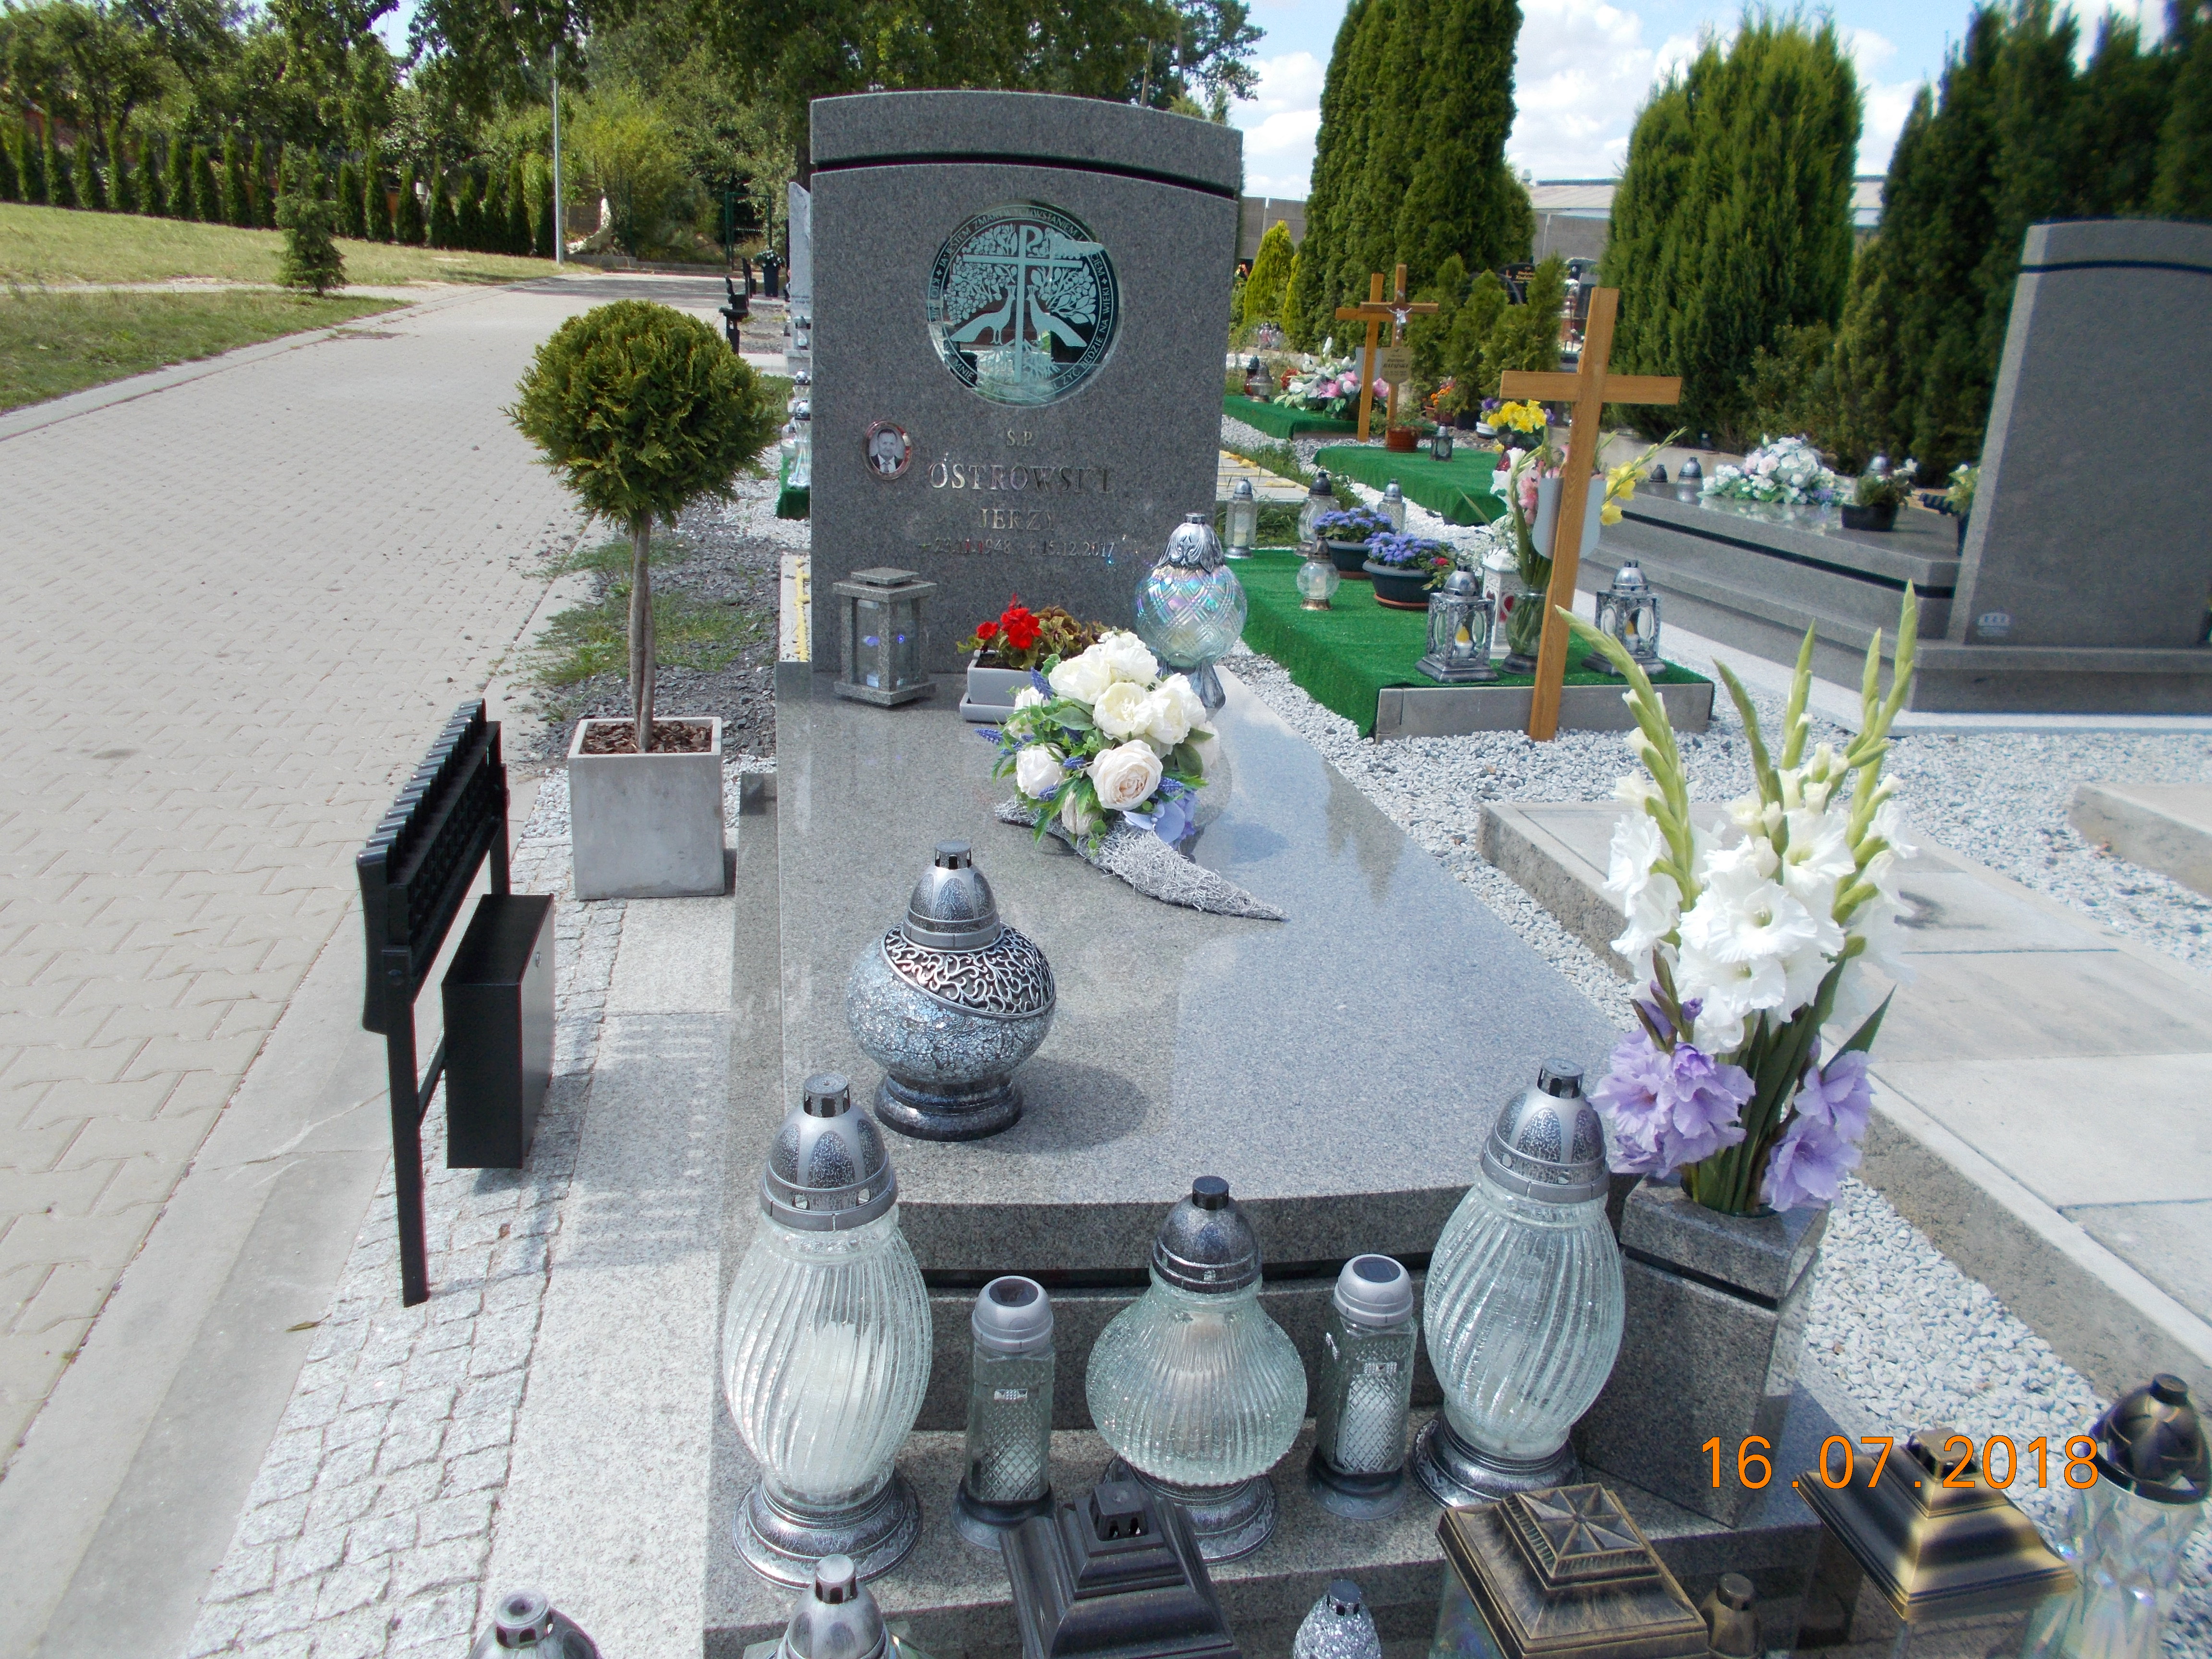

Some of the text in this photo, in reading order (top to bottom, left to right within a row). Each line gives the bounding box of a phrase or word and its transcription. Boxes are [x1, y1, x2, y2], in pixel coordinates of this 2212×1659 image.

[1102, 287, 1111, 314] WIEKI
[1098, 319, 1109, 333] NA
[978, 508, 1055, 531] JERZY
